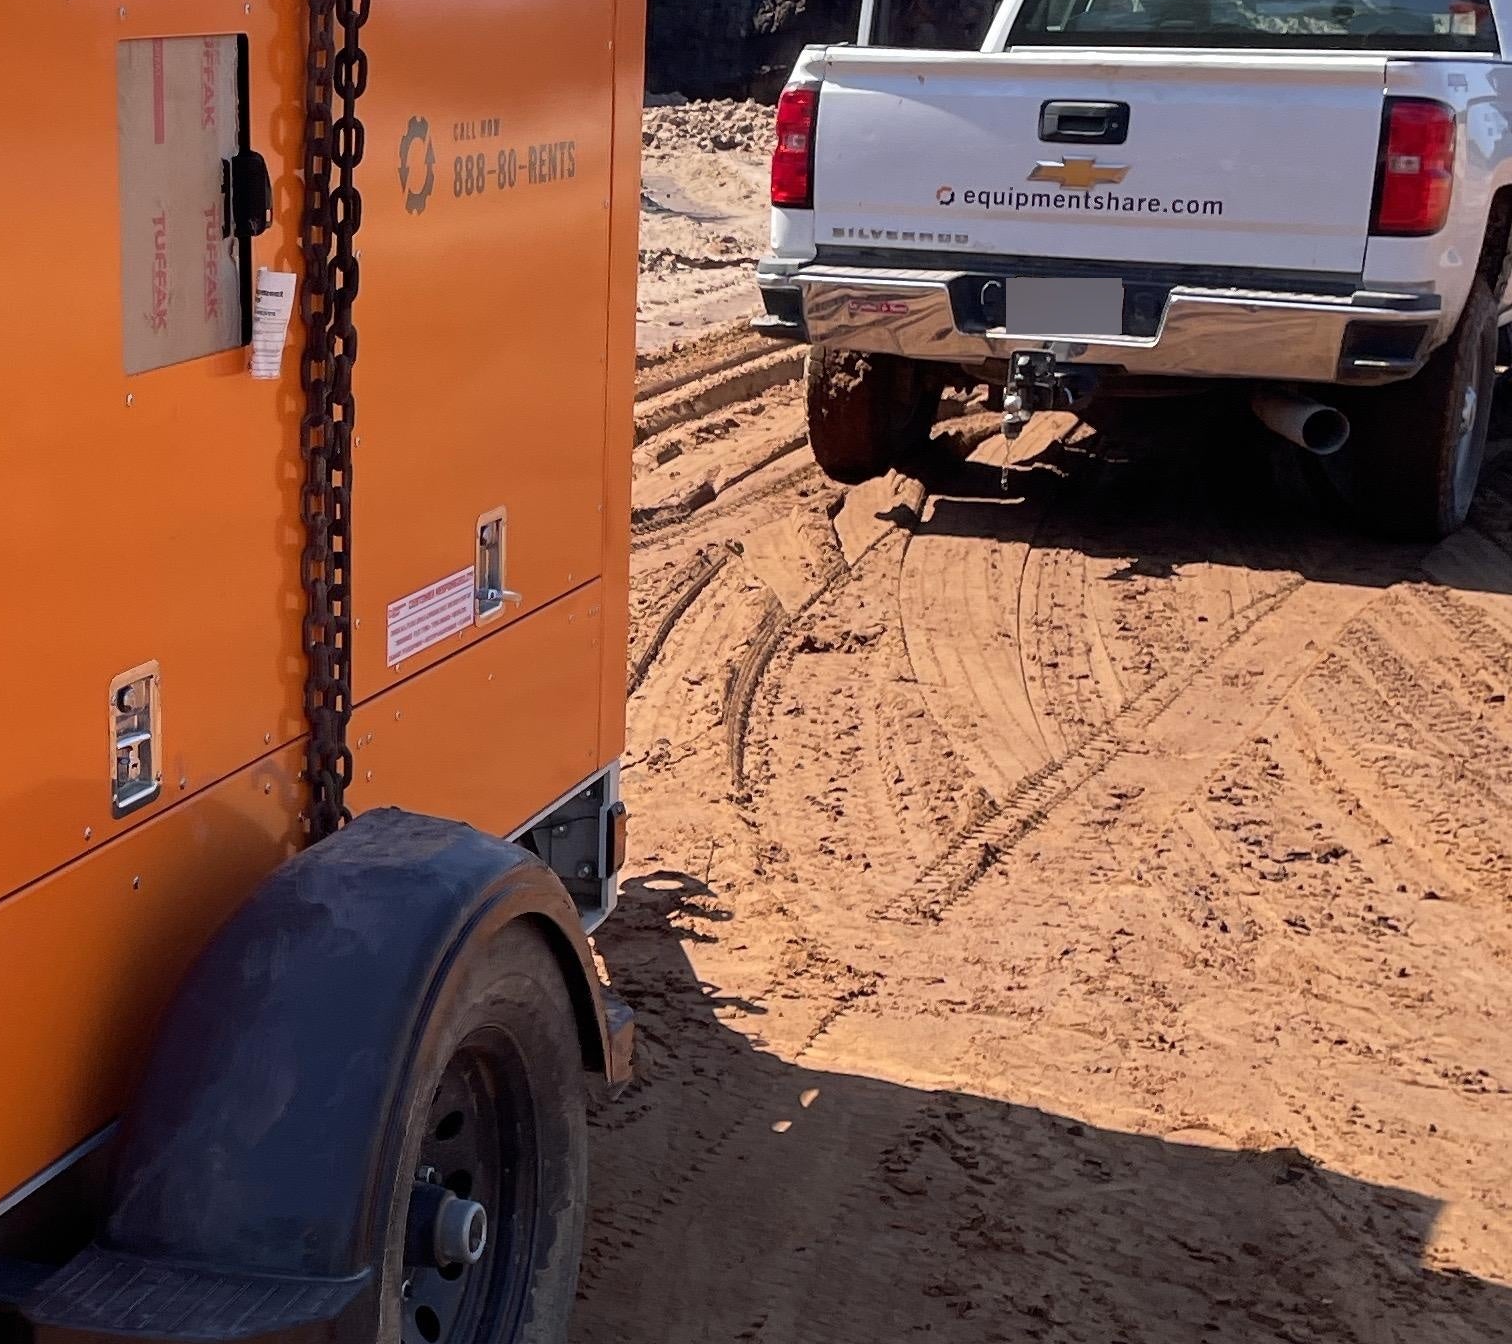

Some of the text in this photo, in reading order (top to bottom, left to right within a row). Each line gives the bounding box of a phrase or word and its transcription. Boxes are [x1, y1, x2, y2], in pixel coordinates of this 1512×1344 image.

[452, 140, 576, 198] 888-80-RENTS
[962, 185, 1224, 217] equipmentshare.com
[202, 202, 221, 320] TUFFAK
[831, 226, 969, 245] SILVERADO
[150, 210, 168, 330] TUFFAK
